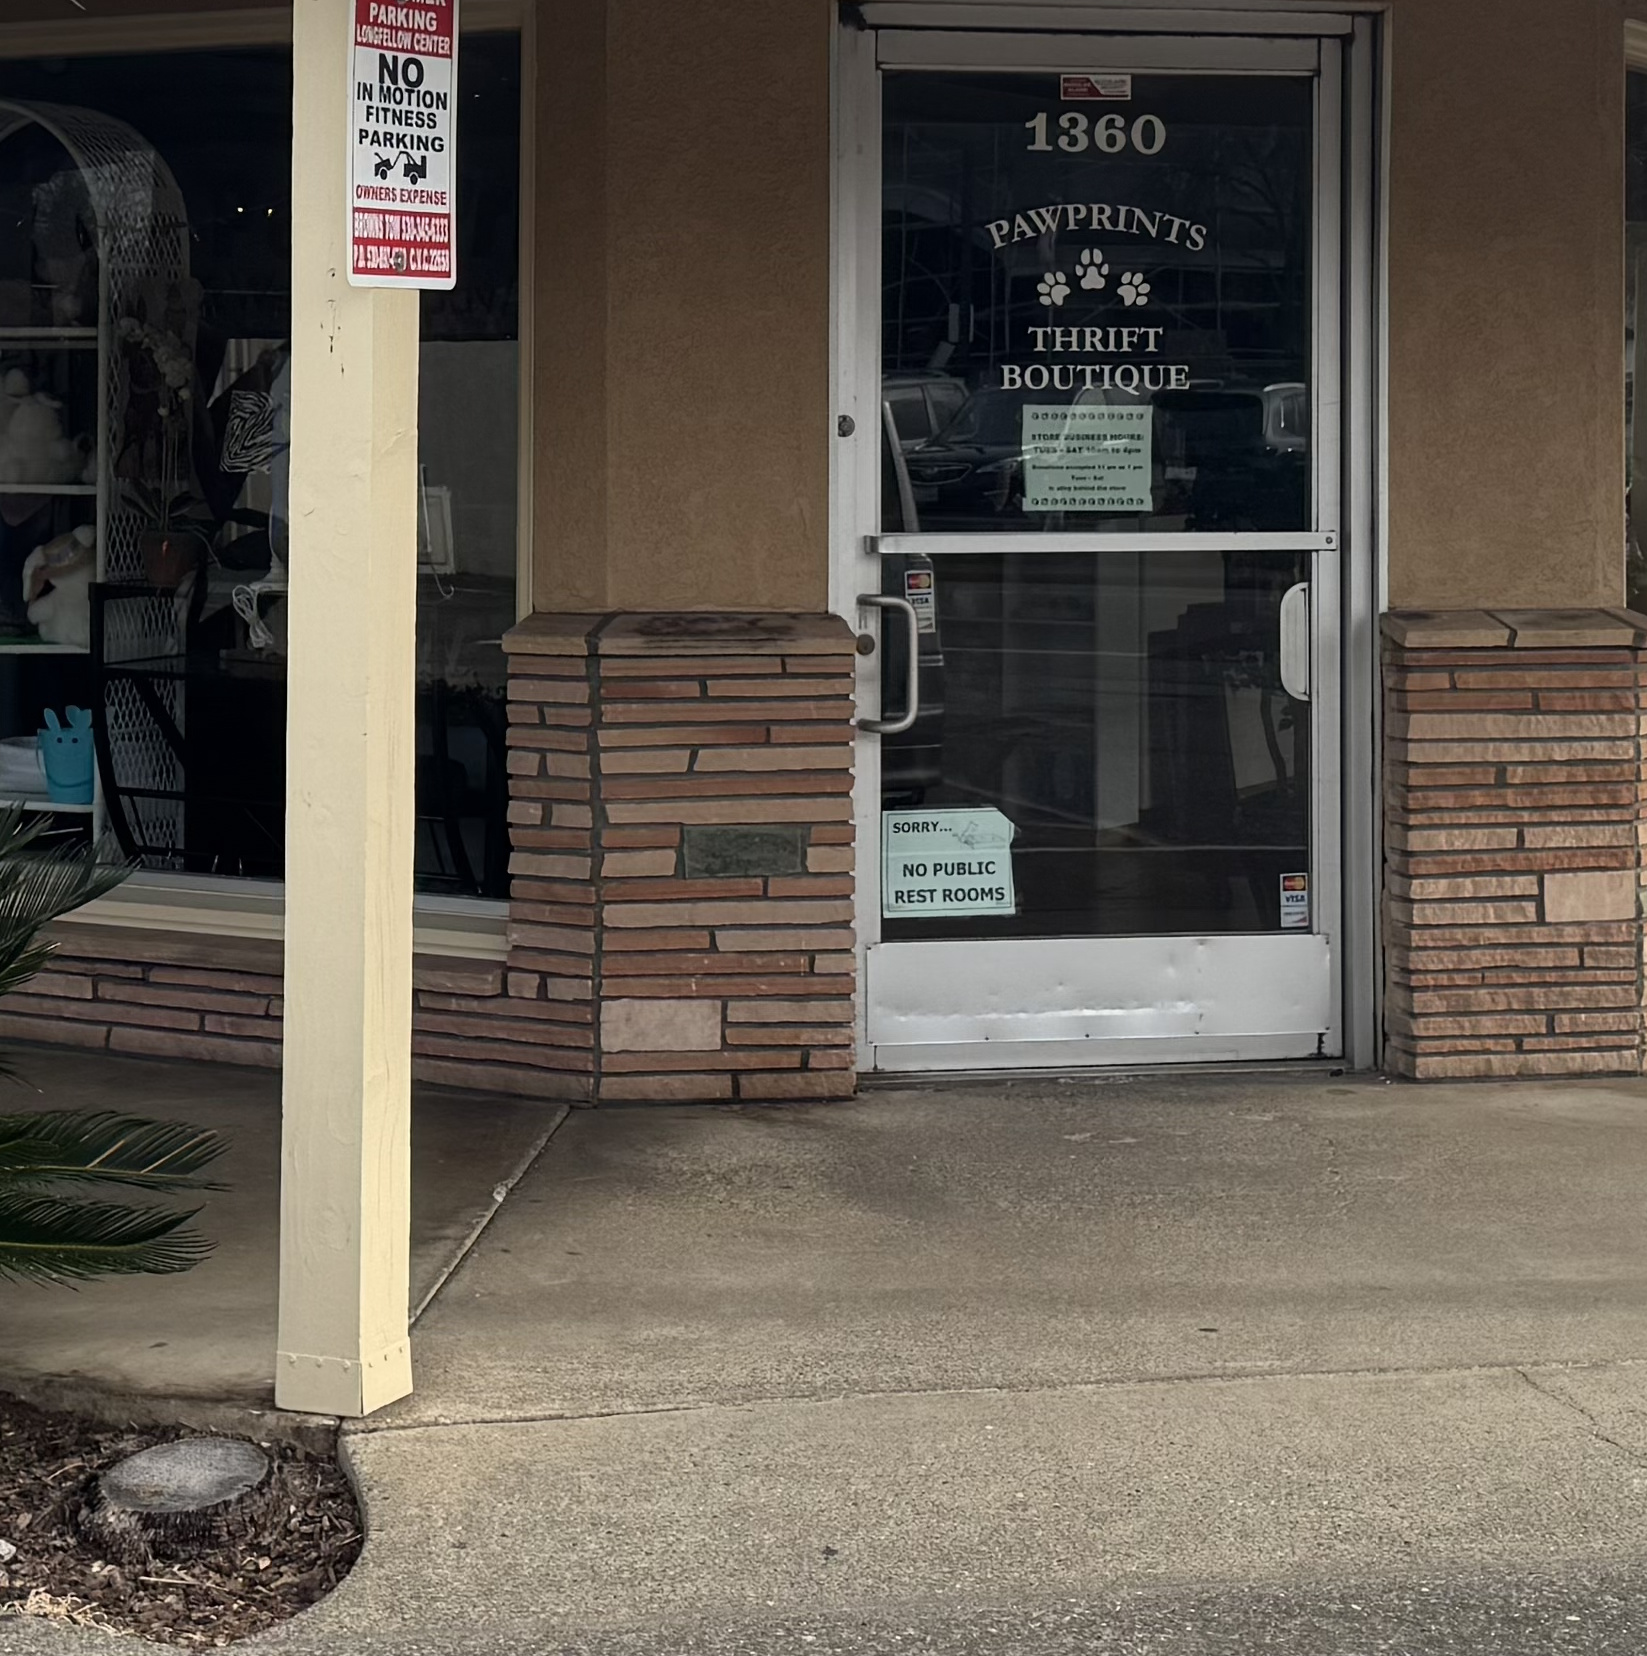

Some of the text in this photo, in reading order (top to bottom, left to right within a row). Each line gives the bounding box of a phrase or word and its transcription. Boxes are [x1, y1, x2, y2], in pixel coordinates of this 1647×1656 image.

[369, 2, 437, 31] PARKING
[413, 32, 450, 55] CENTER
[378, 53, 424, 88] NO
[357, 82, 447, 110] IN MOTION
[365, 105, 437, 129] FITNESS
[358, 128, 444, 153] PARKING
[1024, 112, 1166, 155] 1360
[356, 184, 447, 206] OWNERS EXPENSE
[985, 203, 1207, 251] PAWPRINTS
[1028, 326, 1163, 353] THRIFT
[1000, 364, 1190, 395] BOUTIQUE
[892, 821, 952, 833] SORRY...
[903, 861, 996, 877] NO PUBLIC
[895, 887, 1005, 904] REST ROOMS
